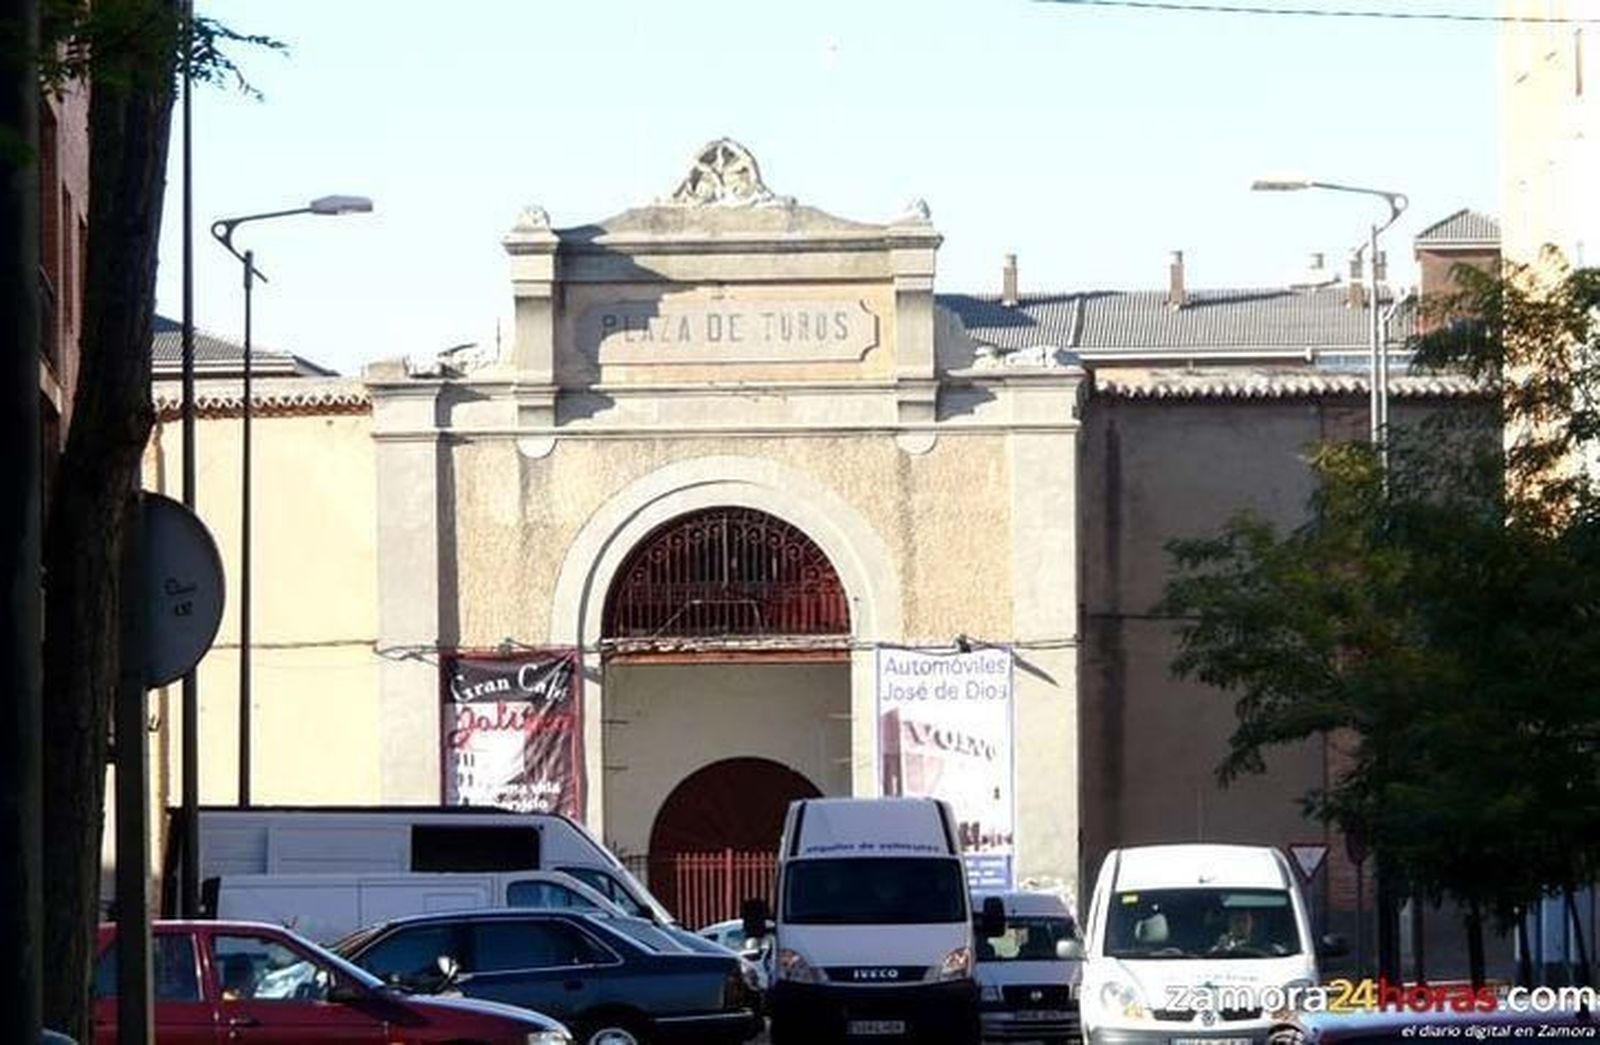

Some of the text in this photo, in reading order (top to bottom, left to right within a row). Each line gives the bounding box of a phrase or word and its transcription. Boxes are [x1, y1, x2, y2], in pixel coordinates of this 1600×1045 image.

[602, 312, 848, 343] PLAZA DE TOROS
[884, 654, 1007, 677] Automóviles
[451, 675, 510, 701] Gran
[883, 681, 1007, 701] José de Dios
[853, 968, 899, 979] IVECO
